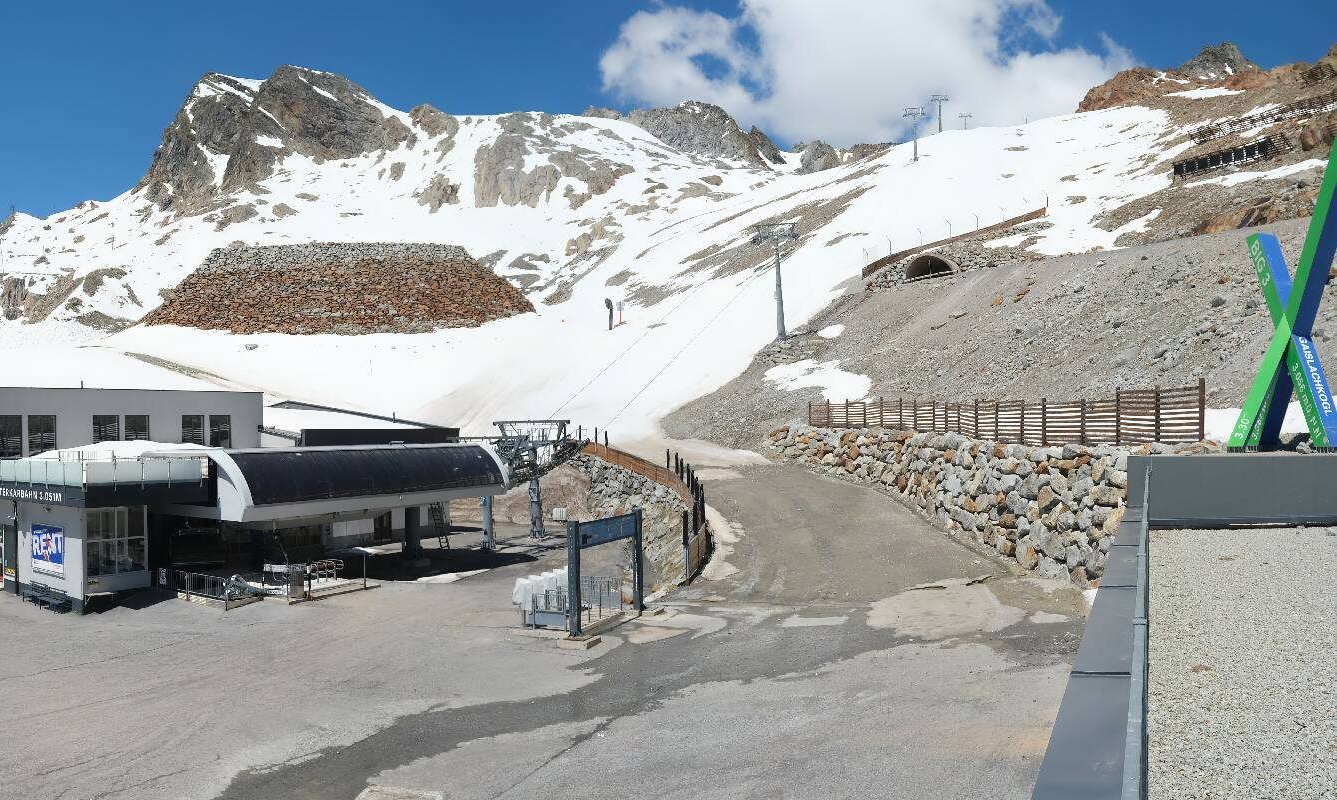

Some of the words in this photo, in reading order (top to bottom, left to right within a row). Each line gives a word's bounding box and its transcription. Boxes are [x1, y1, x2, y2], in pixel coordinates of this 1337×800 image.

[1251, 240, 1266, 273] BIG
[1262, 273, 1271, 287] 3
[1298, 336, 1333, 417] GAISLACHKOGL
[1234, 412, 1250, 440] 3.30
[32, 532, 63, 556] RENT
